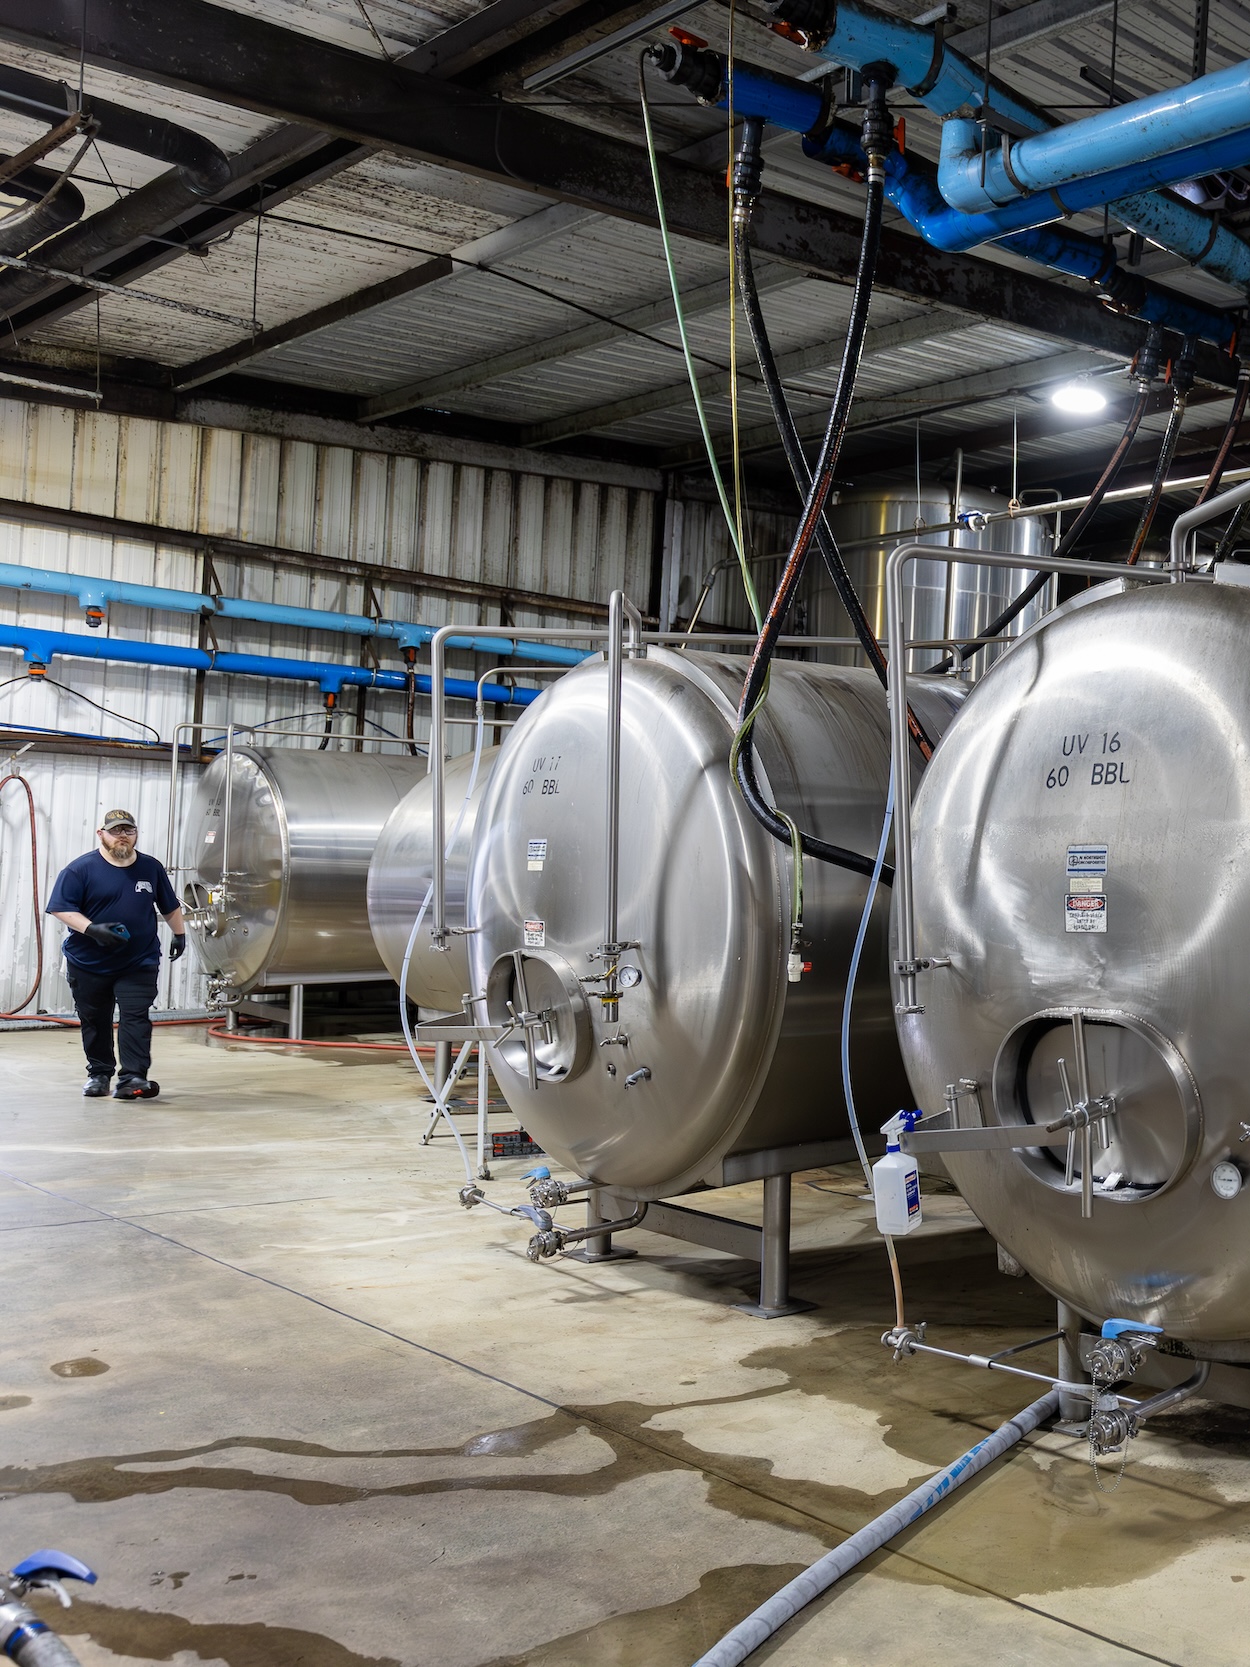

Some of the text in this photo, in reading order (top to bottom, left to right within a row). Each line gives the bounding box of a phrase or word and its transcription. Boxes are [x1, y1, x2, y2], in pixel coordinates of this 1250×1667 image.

[1062, 731, 1121, 757] UV 16
[532, 757, 546, 772] UV
[1046, 762, 1130, 789] 60 BBL
[522, 779, 560, 795] 60 BBL
[1072, 899, 1099, 908] DANGER
